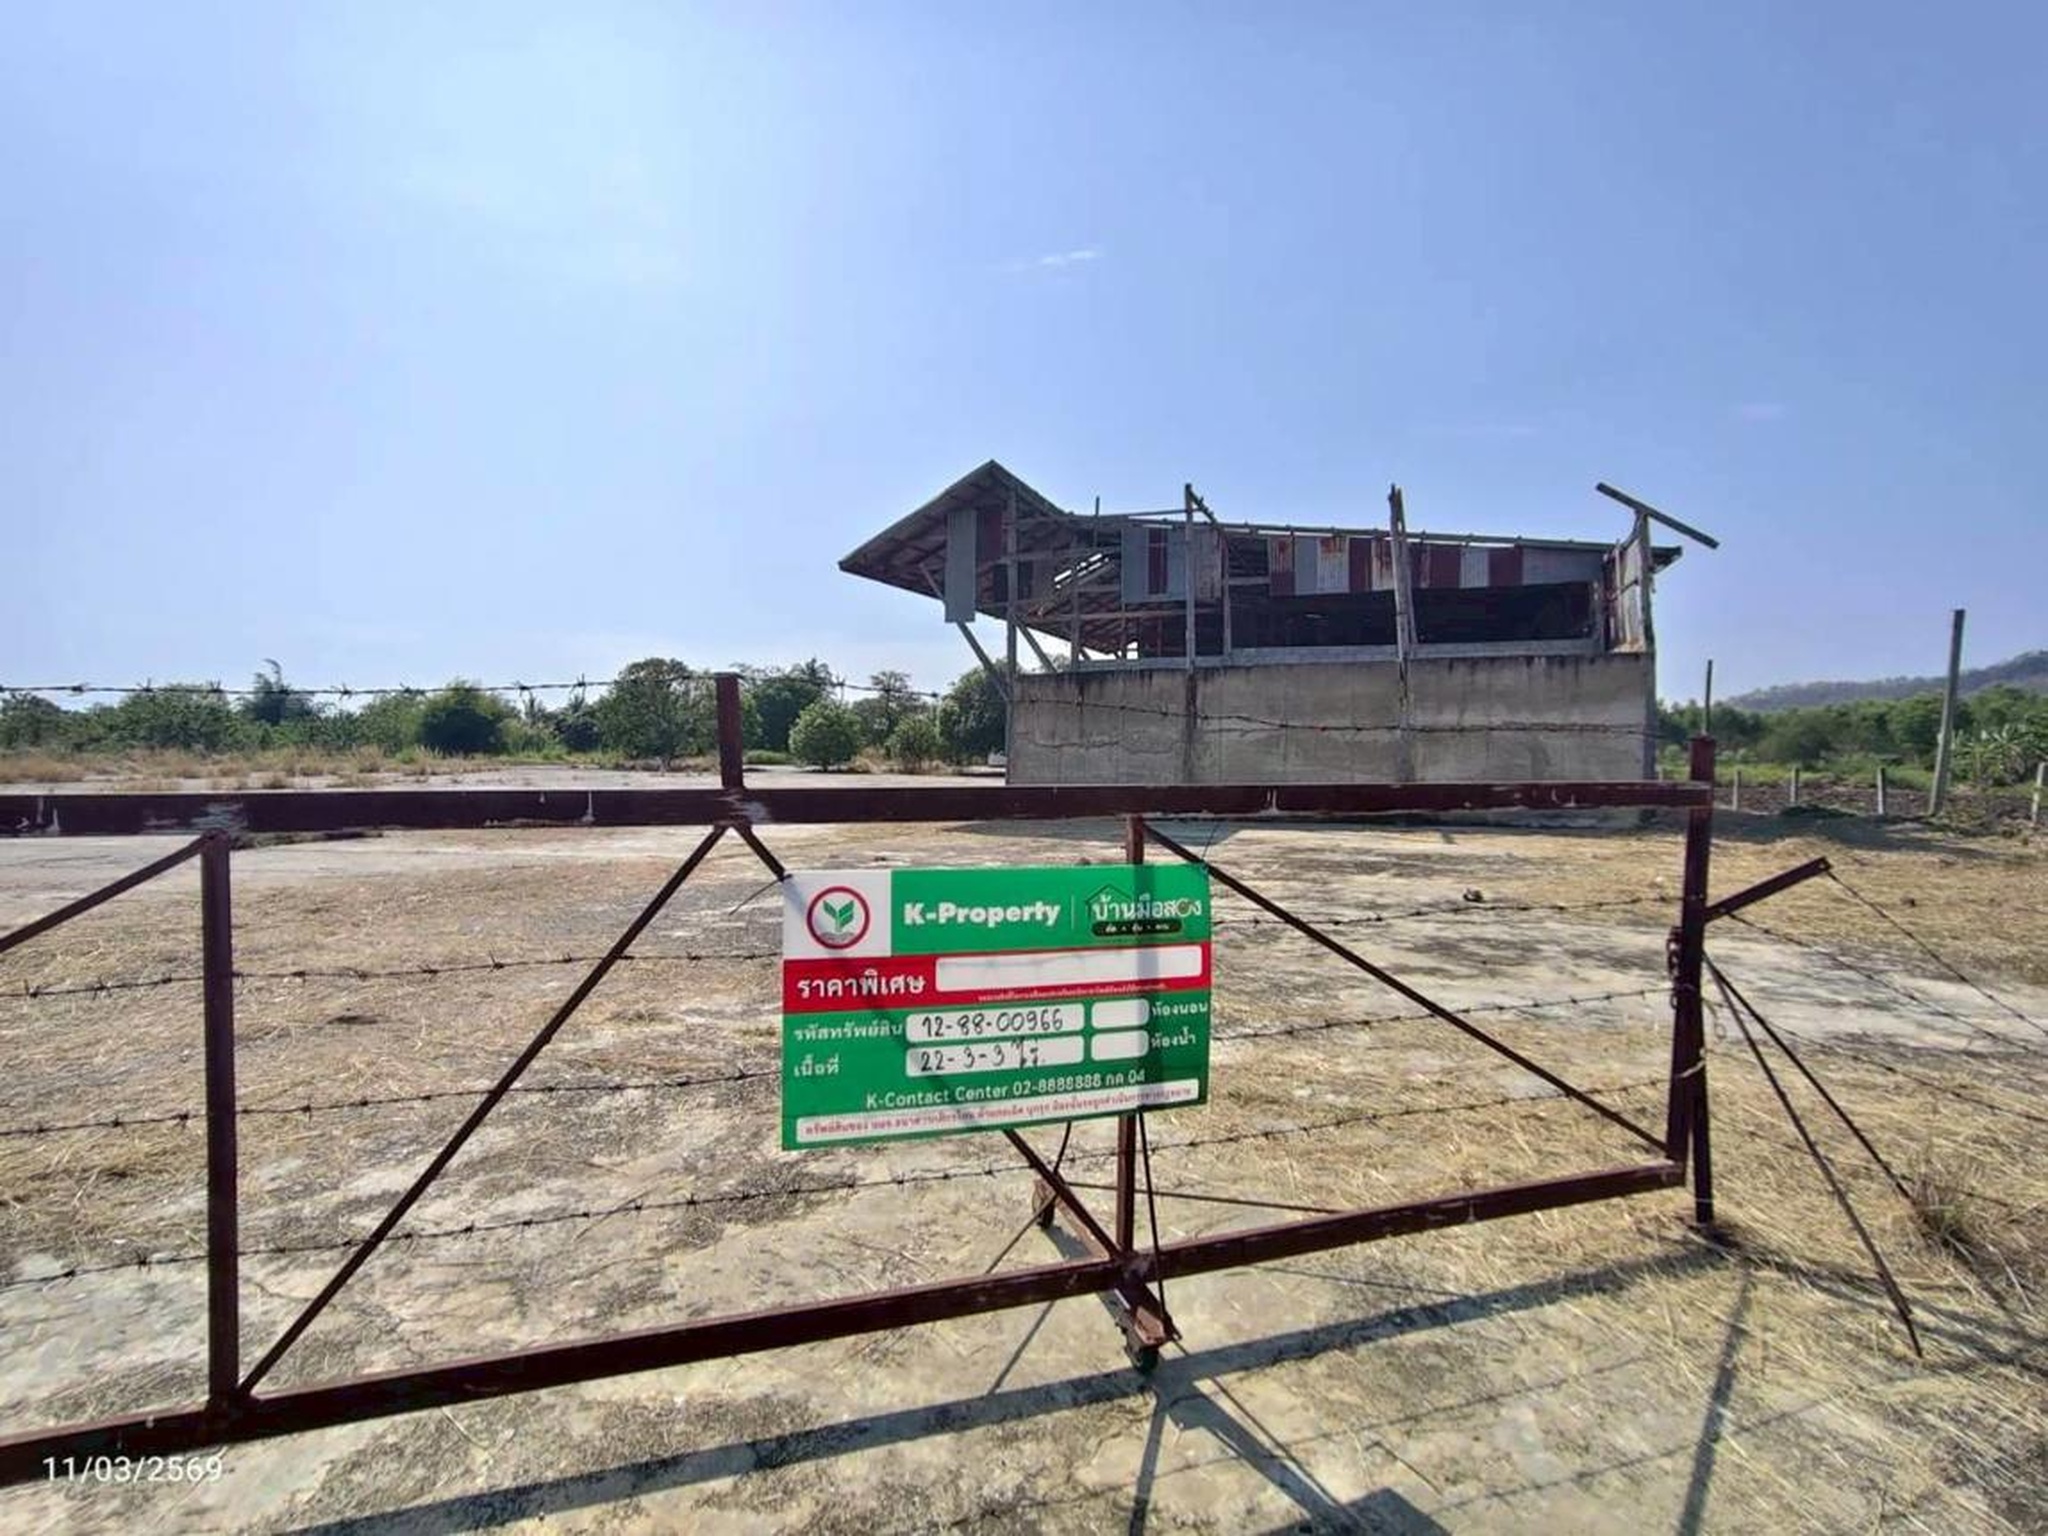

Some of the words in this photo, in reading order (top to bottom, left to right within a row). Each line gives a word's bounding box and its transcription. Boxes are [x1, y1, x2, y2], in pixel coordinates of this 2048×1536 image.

[904, 901, 1062, 928] K-Property
[1092, 893, 1202, 921] บ้านมือสอง
[797, 968, 926, 999] ราคาพิเศษ
[1151, 1000, 1208, 1017] ห้องนอน
[793, 1018, 903, 1042] รหัสทรัพย์สิน
[921, 1007, 1064, 1038] 12-88-00966
[1151, 1028, 1196, 1048] ห้องน้ำ
[793, 1053, 840, 1077] เนื้อที่
[866, 1091, 949, 1109] K-Contact
[955, 1086, 1008, 1101] Center
[1012, 1073, 1101, 1095] 02-8888888
[1128, 1069, 1145, 1082] 04
